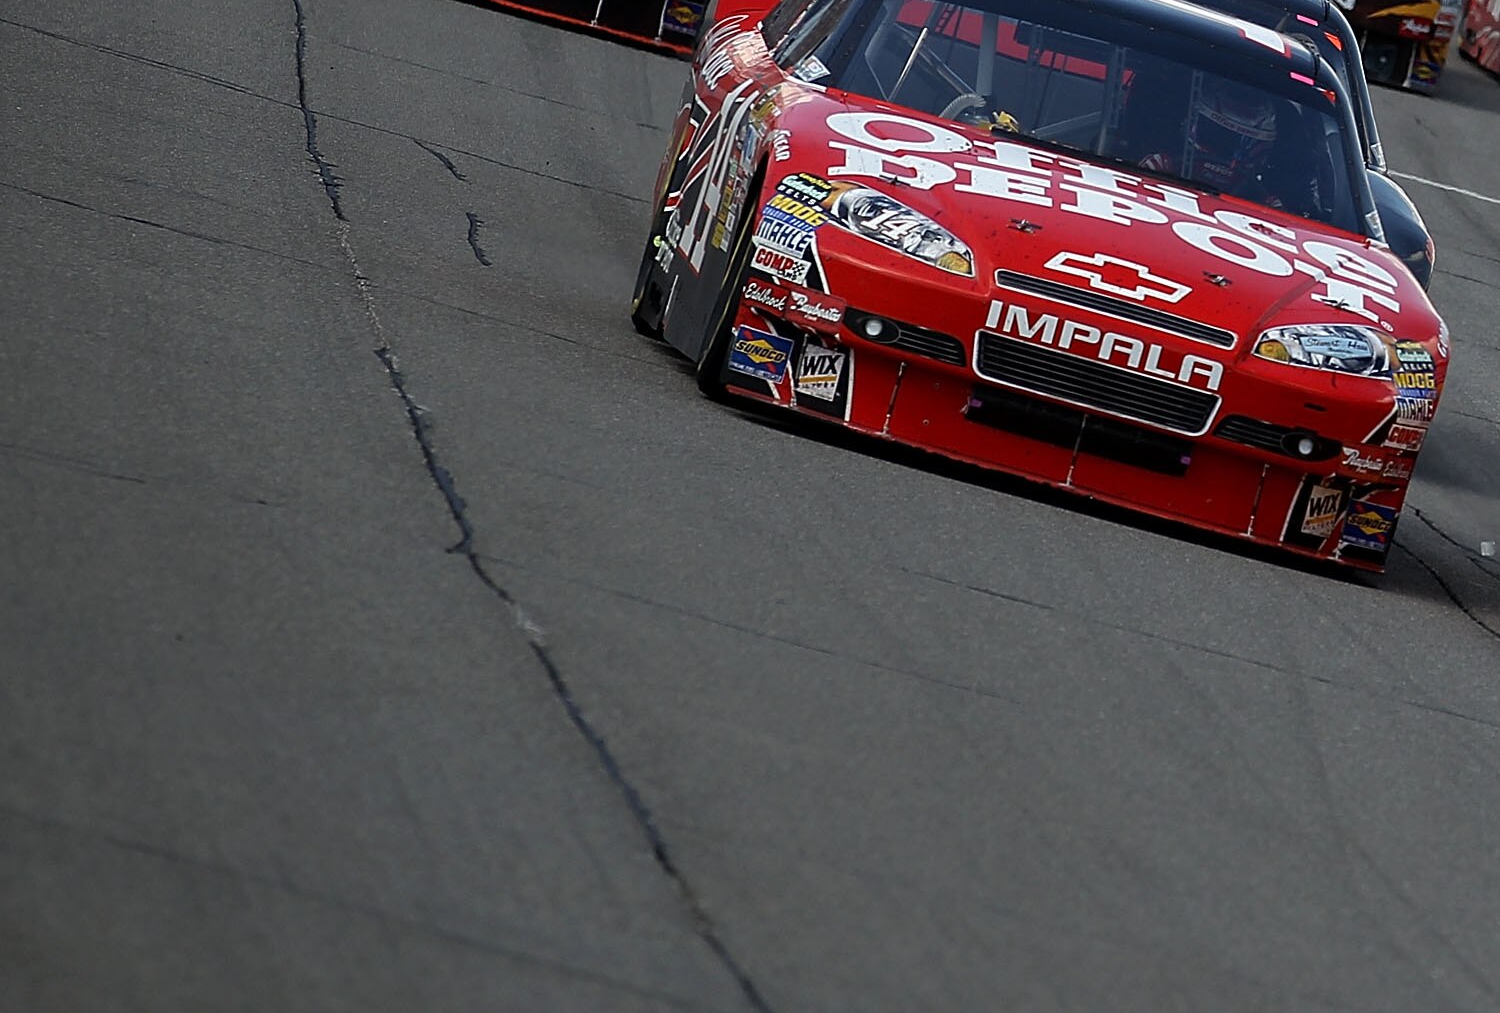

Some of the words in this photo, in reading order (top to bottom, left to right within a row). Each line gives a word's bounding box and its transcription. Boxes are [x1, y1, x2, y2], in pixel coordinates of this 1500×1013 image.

[777, 185, 818, 206] BELTS
[767, 194, 829, 227] MOOG
[758, 218, 815, 253] MAHLE
[827, 140, 1401, 324] DEPOT
[862, 208, 915, 240] 14
[755, 248, 794, 272] COMP
[743, 282, 787, 311] Edelbrock
[736, 339, 786, 364] SUNOCO
[984, 298, 1225, 392] IMPALA
[803, 353, 842, 376] WIX
[1393, 372, 1435, 389] MOOG
[1309, 492, 1342, 516] WIX
[1349, 514, 1393, 533] SUNOCO
